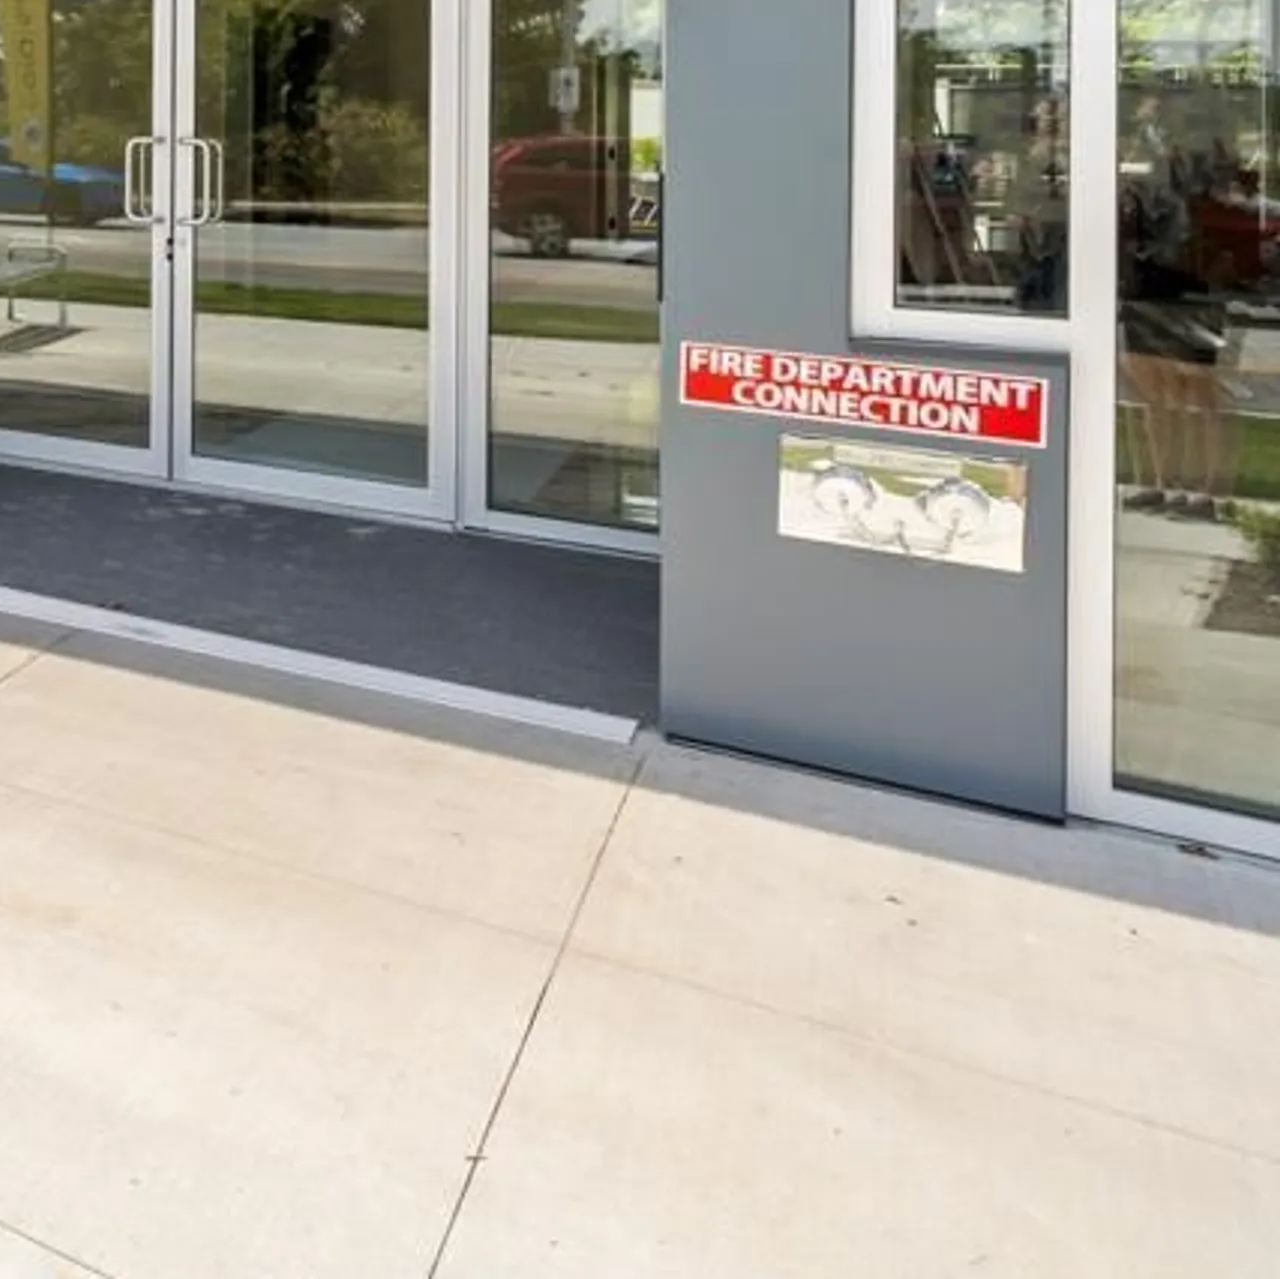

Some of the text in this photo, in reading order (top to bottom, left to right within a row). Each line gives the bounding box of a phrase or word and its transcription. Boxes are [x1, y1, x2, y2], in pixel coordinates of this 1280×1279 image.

[689, 347, 1037, 410] FIRE DEPARTMENT
[732, 379, 982, 433] CONNECTION
